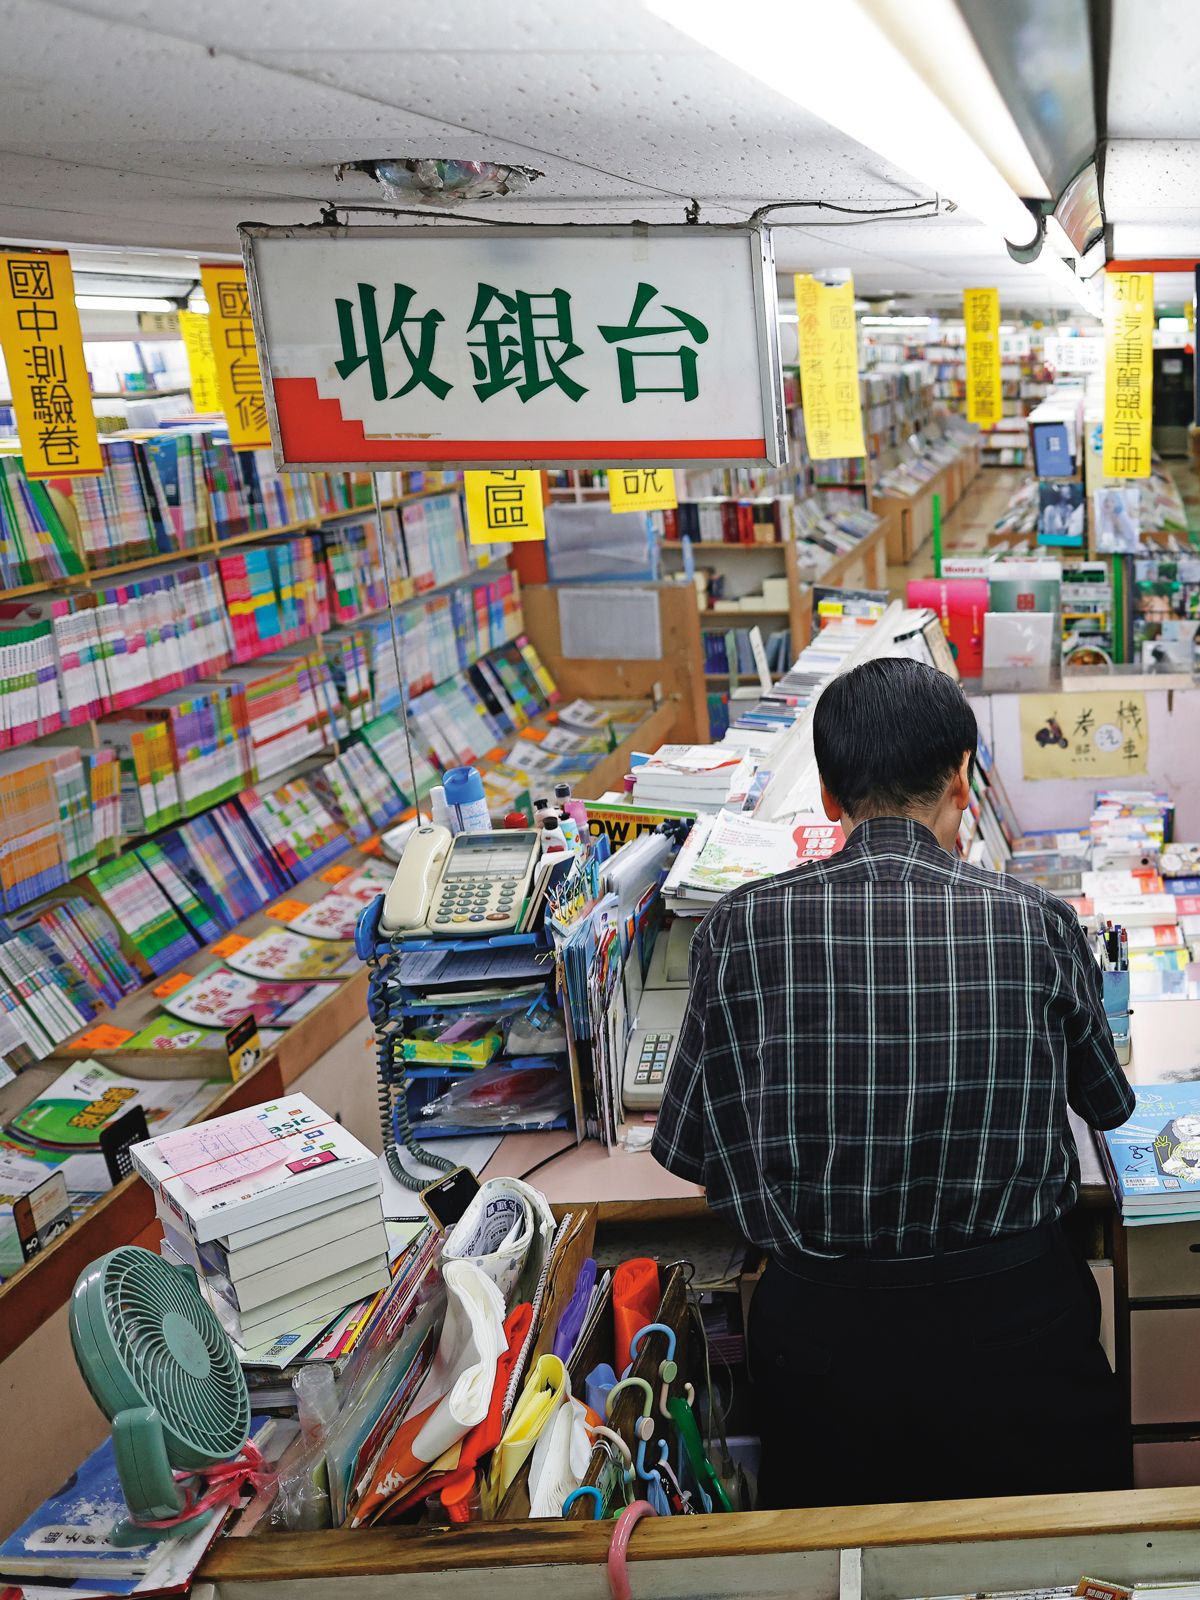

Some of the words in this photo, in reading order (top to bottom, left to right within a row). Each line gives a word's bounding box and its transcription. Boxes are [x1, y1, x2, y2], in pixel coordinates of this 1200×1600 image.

[7, 259, 79, 466] 國中測驗卷
[334, 281, 709, 404] 收銀台
